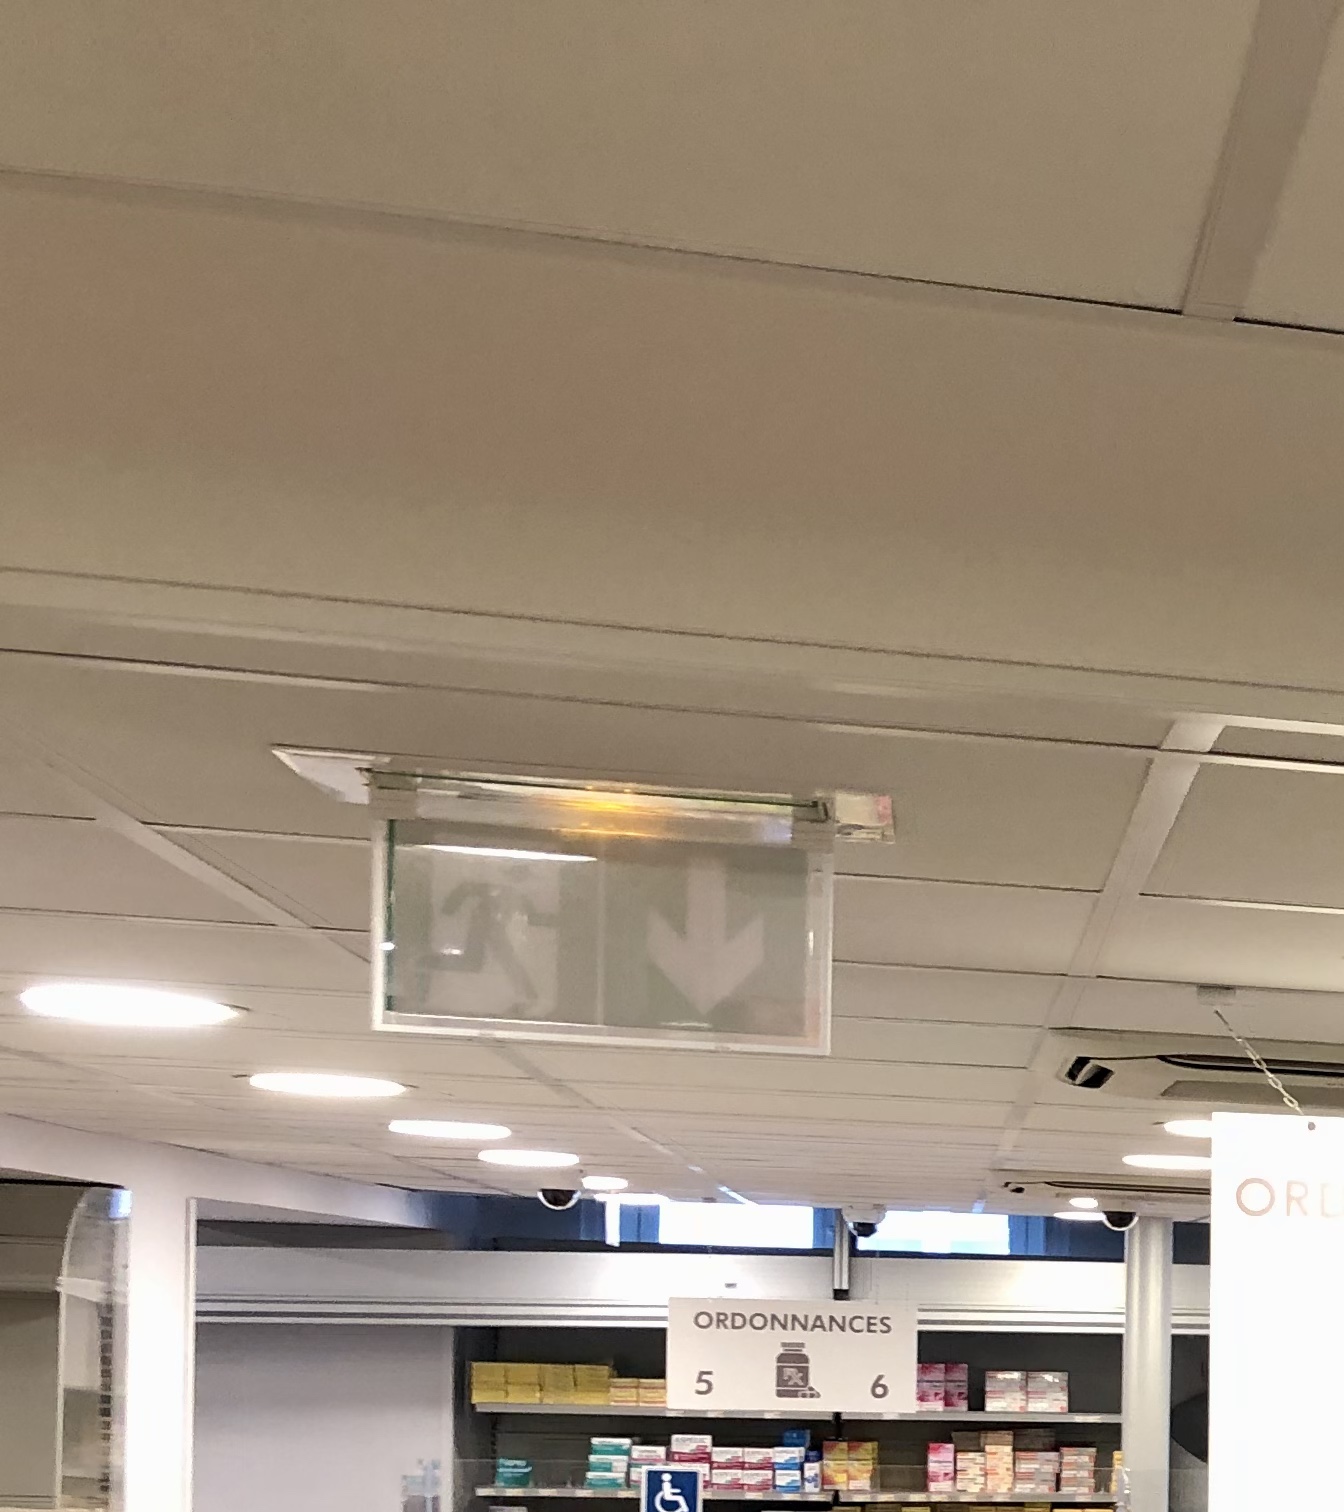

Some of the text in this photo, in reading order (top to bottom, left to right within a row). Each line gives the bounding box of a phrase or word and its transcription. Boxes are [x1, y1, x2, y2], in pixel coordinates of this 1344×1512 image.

[694, 1311, 892, 1334] ORDONNANCES
[695, 1370, 713, 1395] 5
[871, 1374, 889, 1398] 6
